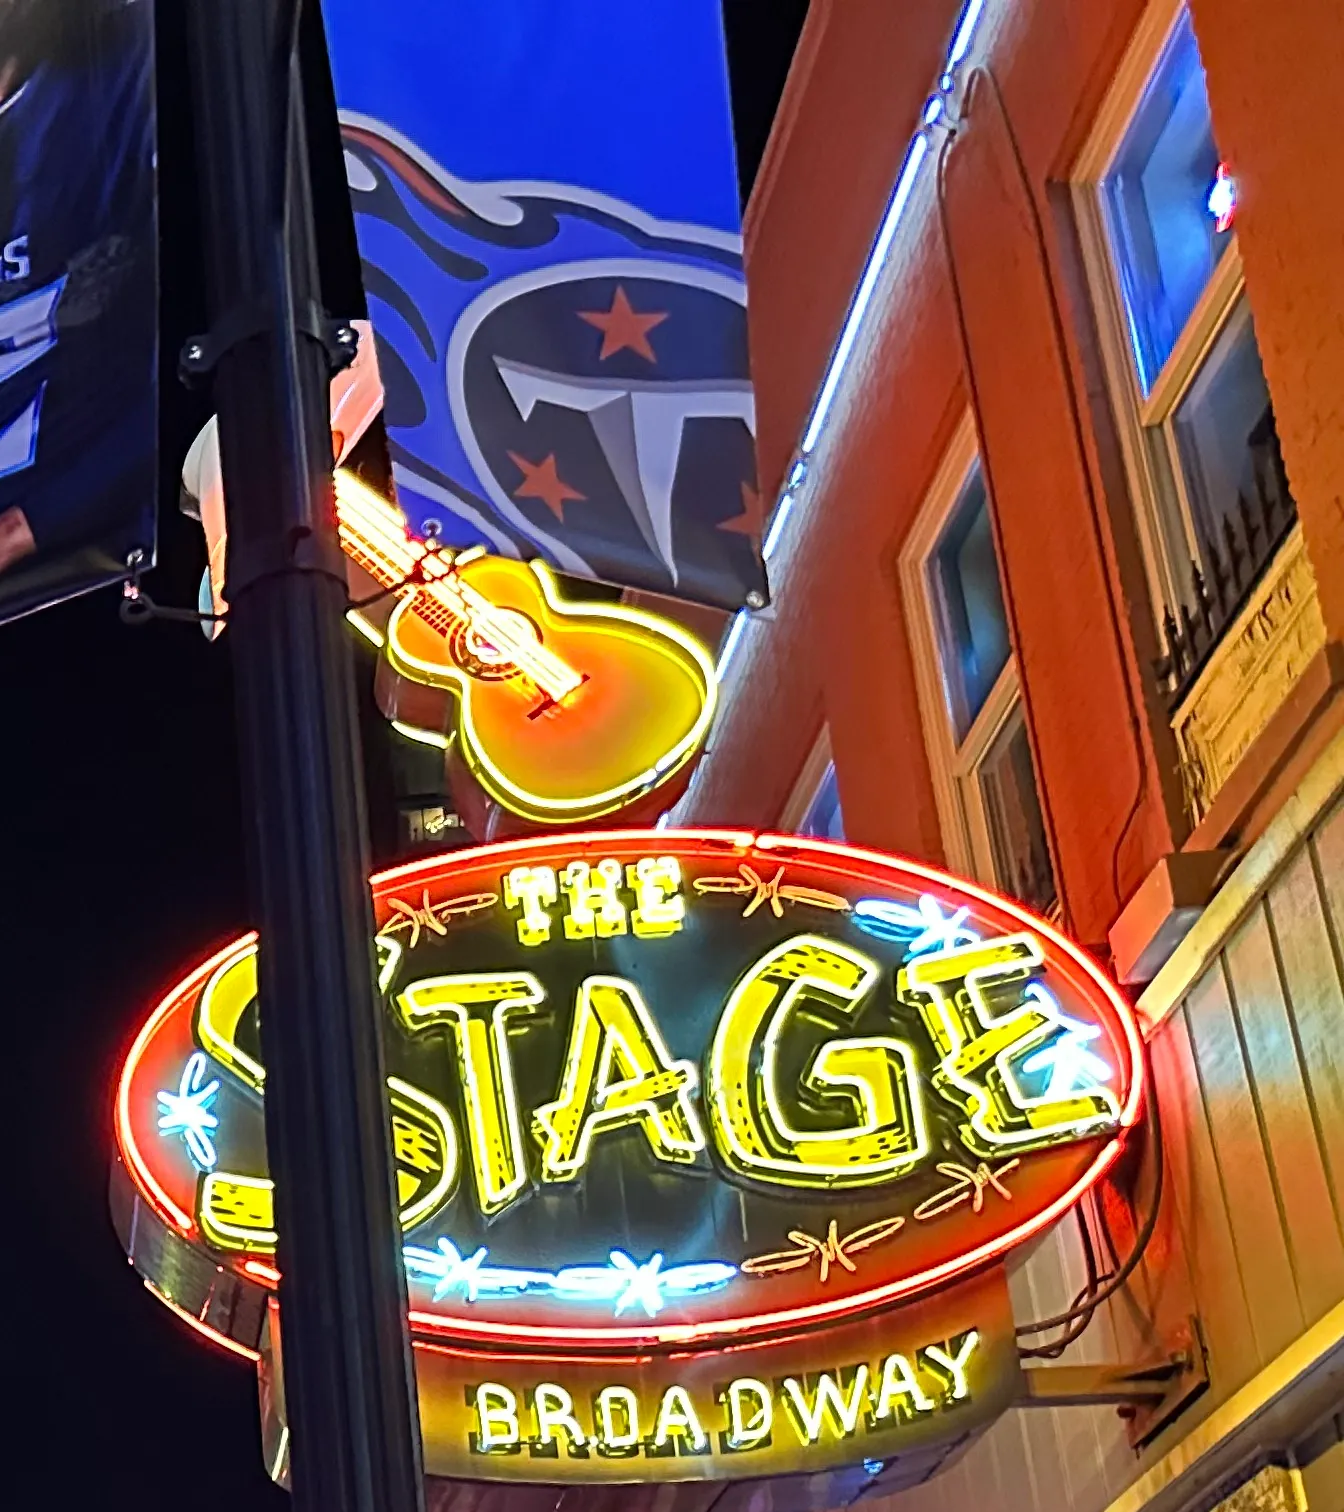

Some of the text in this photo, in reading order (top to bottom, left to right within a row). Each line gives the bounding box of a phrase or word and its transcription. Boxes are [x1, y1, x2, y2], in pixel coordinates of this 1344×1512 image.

[502, 856, 686, 946] THE
[198, 932, 1122, 1254] STAGE
[466, 1328, 980, 1460] BROADWAY
